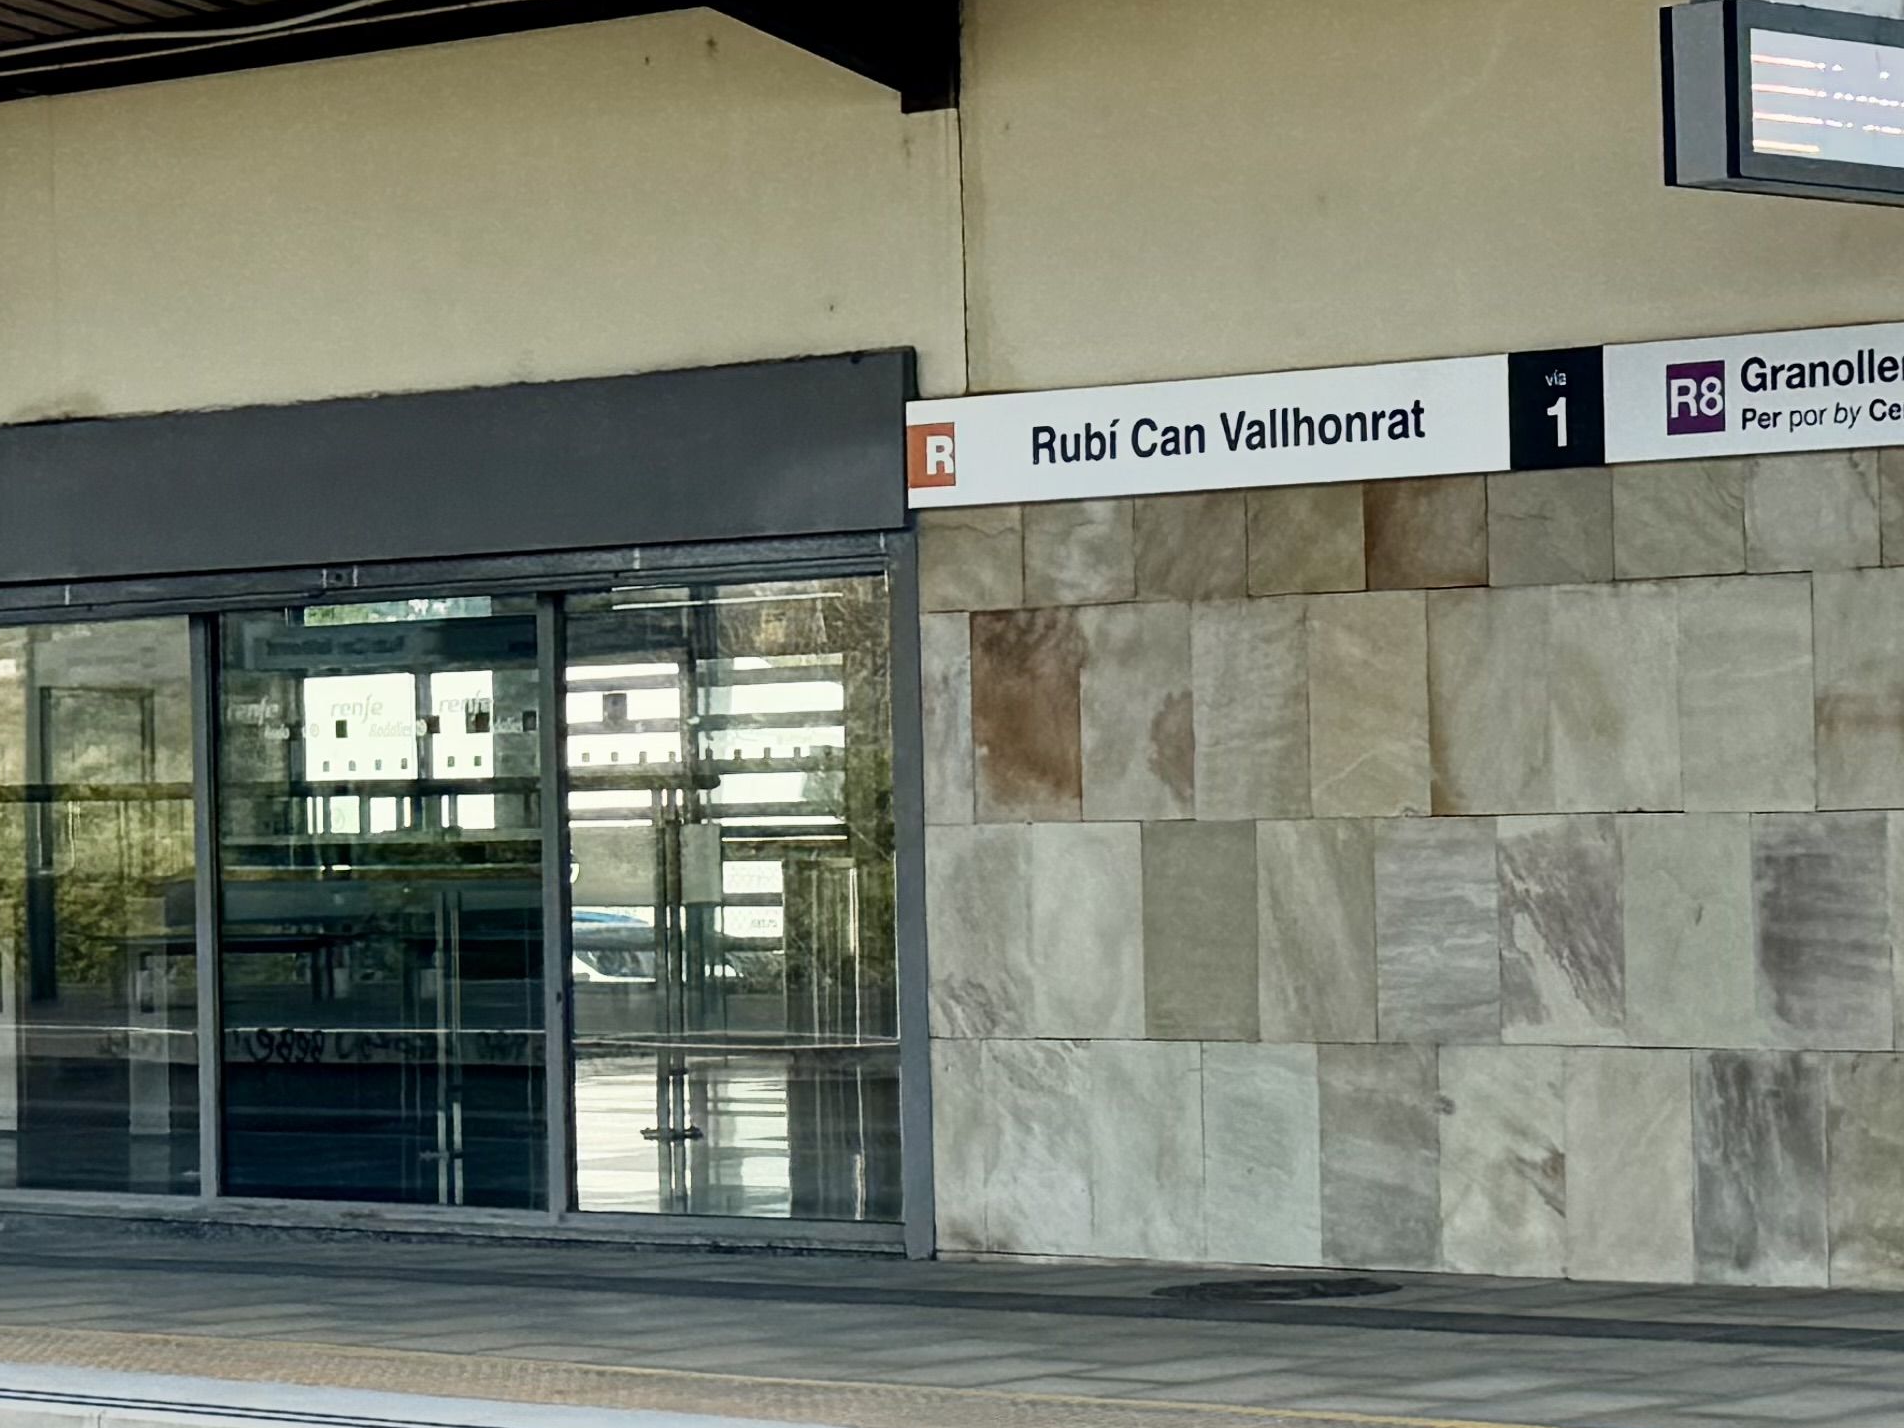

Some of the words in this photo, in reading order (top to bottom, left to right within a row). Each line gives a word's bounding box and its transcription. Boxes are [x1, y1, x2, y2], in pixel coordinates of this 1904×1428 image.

[1545, 369, 1568, 387] vía
[1669, 375, 1724, 419] R8
[1031, 417, 1121, 465] Rubí
[1130, 420, 1206, 459] Can
[1220, 399, 1427, 454] Vallhonrat
[1546, 396, 1568, 448] 1
[1741, 405, 1780, 431] Per
[1788, 405, 1828, 434] por
[1832, 400, 1864, 430] by
[926, 435, 955, 475] R
